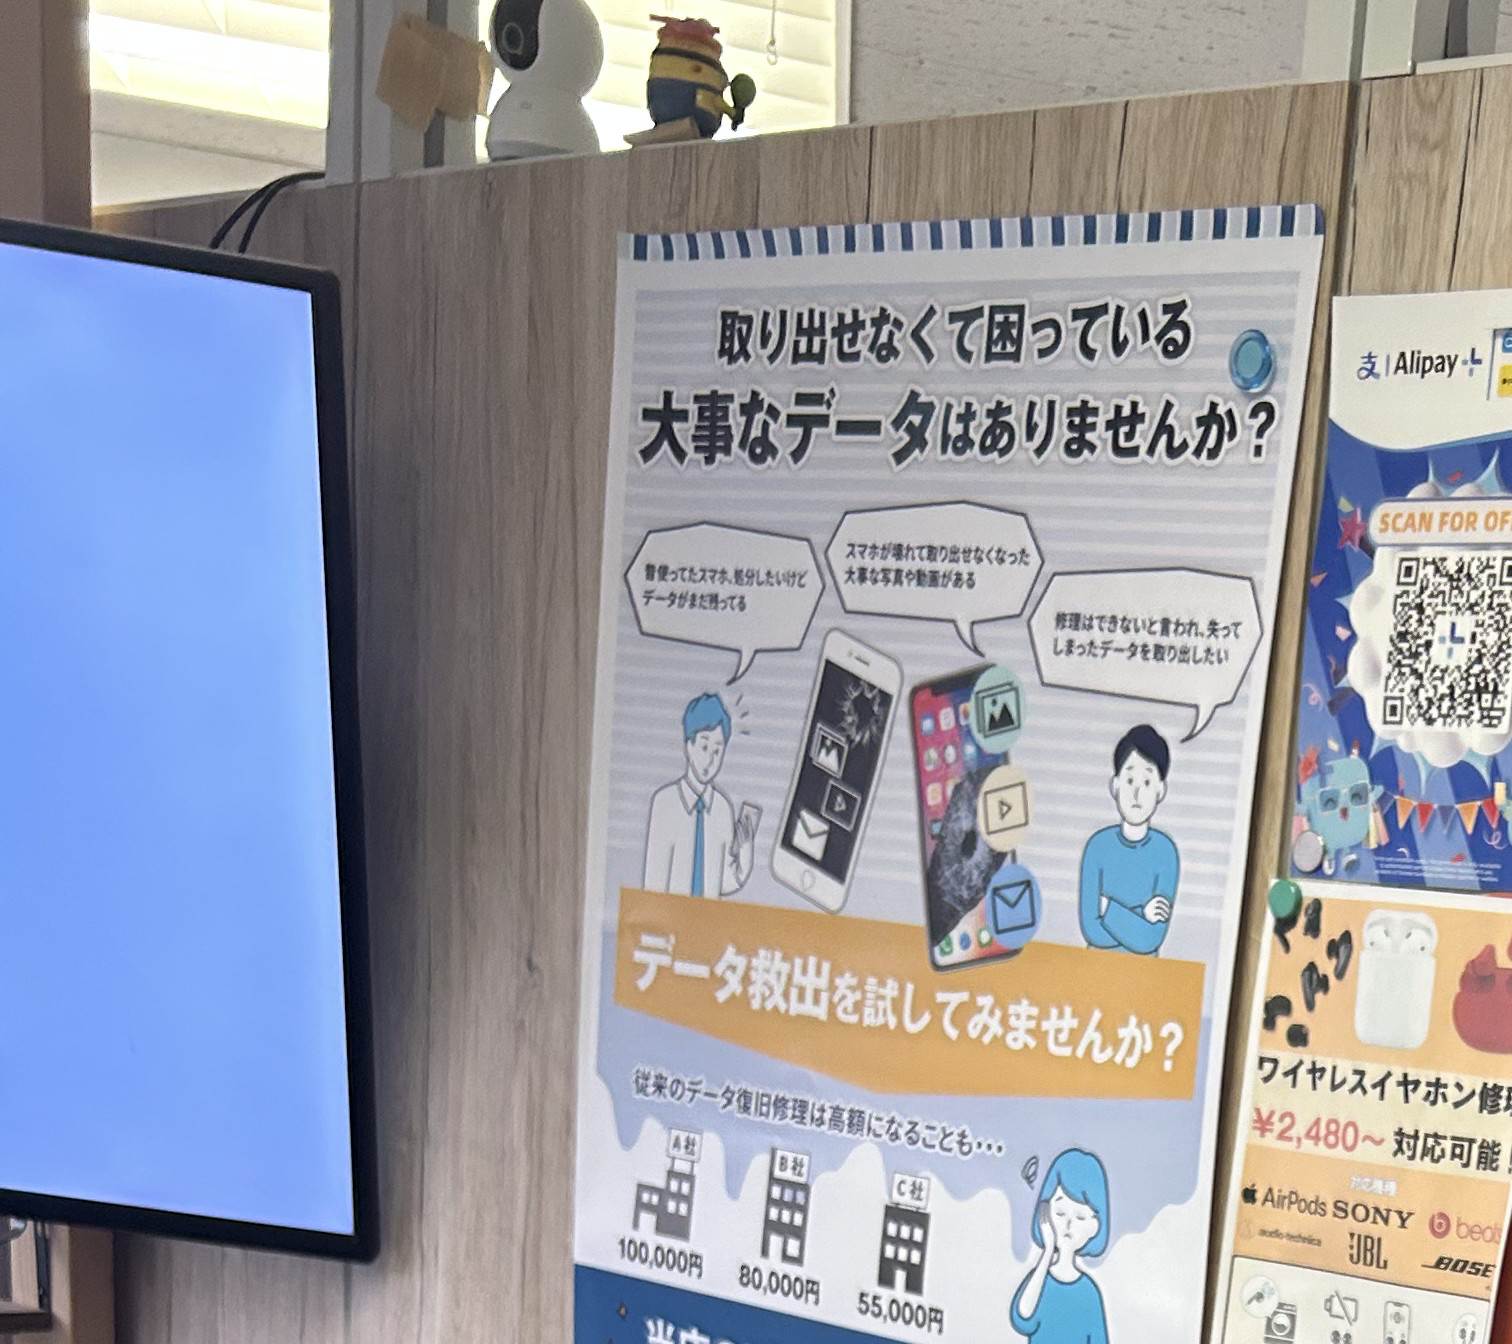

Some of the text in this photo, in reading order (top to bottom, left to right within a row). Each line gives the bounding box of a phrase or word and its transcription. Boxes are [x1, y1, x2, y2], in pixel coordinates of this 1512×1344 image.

[717, 300, 1193, 366] 取り出せなくて困っている
[638, 389, 1276, 466] 大事なデータはありませんか？
[1379, 511, 1435, 533] SCAN
[1439, 510, 1476, 531] FOR
[845, 566, 976, 589] 大事な写真や動画がある
[1055, 612, 1242, 639] 修理はできないと言われ、失って
[1053, 638, 1229, 665] しまったデータを取り出したい
[633, 934, 1185, 1072] データ救出を試してみませんか？
[1262, 1186, 1327, 1217] AirPods
[1333, 1200, 1415, 1229] SONY
[618, 1236, 703, 1279] 100,000円
[1434, 1255, 1497, 1278] BOSE
[739, 1265, 819, 1306] 80,000円
[858, 1292, 944, 1335] 55,000円
